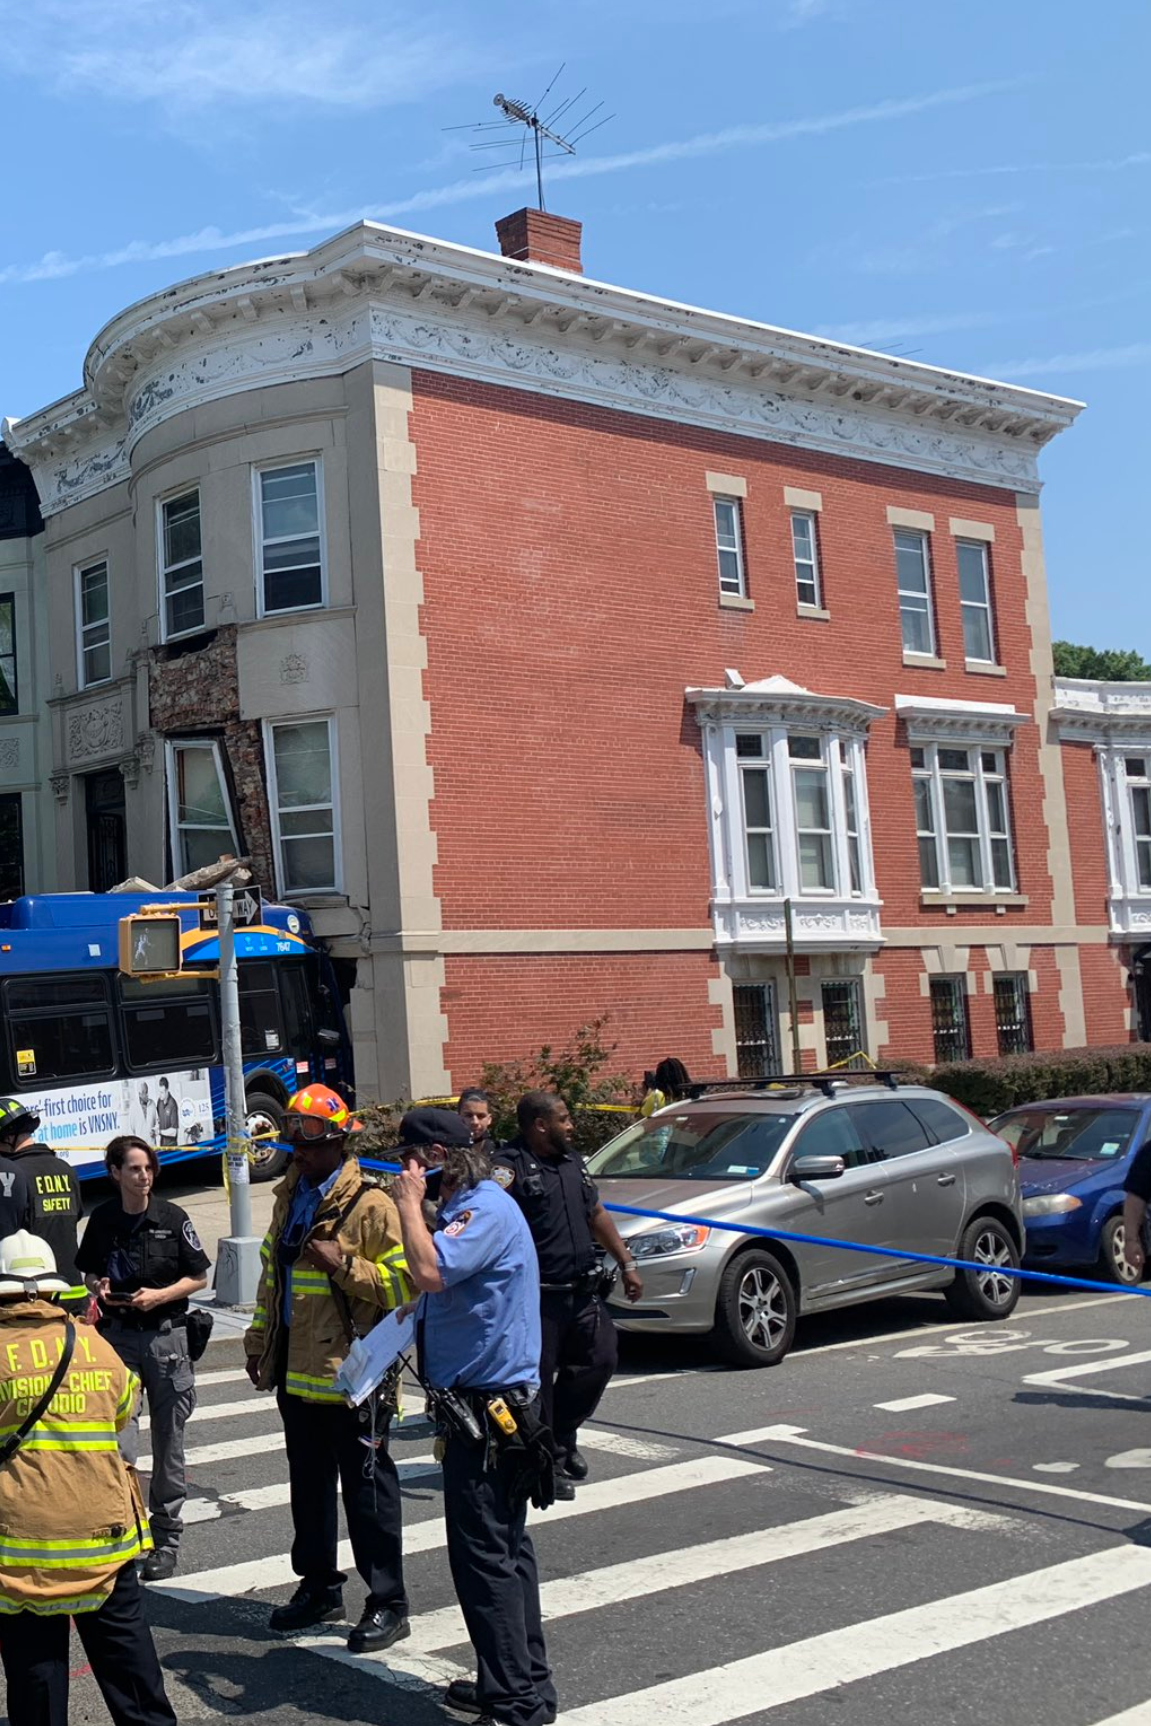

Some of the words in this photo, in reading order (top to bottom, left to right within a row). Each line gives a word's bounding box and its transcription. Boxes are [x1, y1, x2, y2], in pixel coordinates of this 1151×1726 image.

[236, 899, 253, 915] WAY
[276, 942, 290, 952] 7647
[44, 1098, 66, 1117] first
[68, 1094, 96, 1113] choice
[98, 1090, 111, 1108] for
[38, 1126, 48, 1142] at
[51, 1122, 77, 1140] home
[79, 1118, 87, 1135] is
[88, 1111, 120, 1134] VNSNY.
[42, 1197, 70, 1212] SAFETY
[69, 1370, 113, 1393] CHIEF
[16, 1393, 86, 1417] CLUDIO
